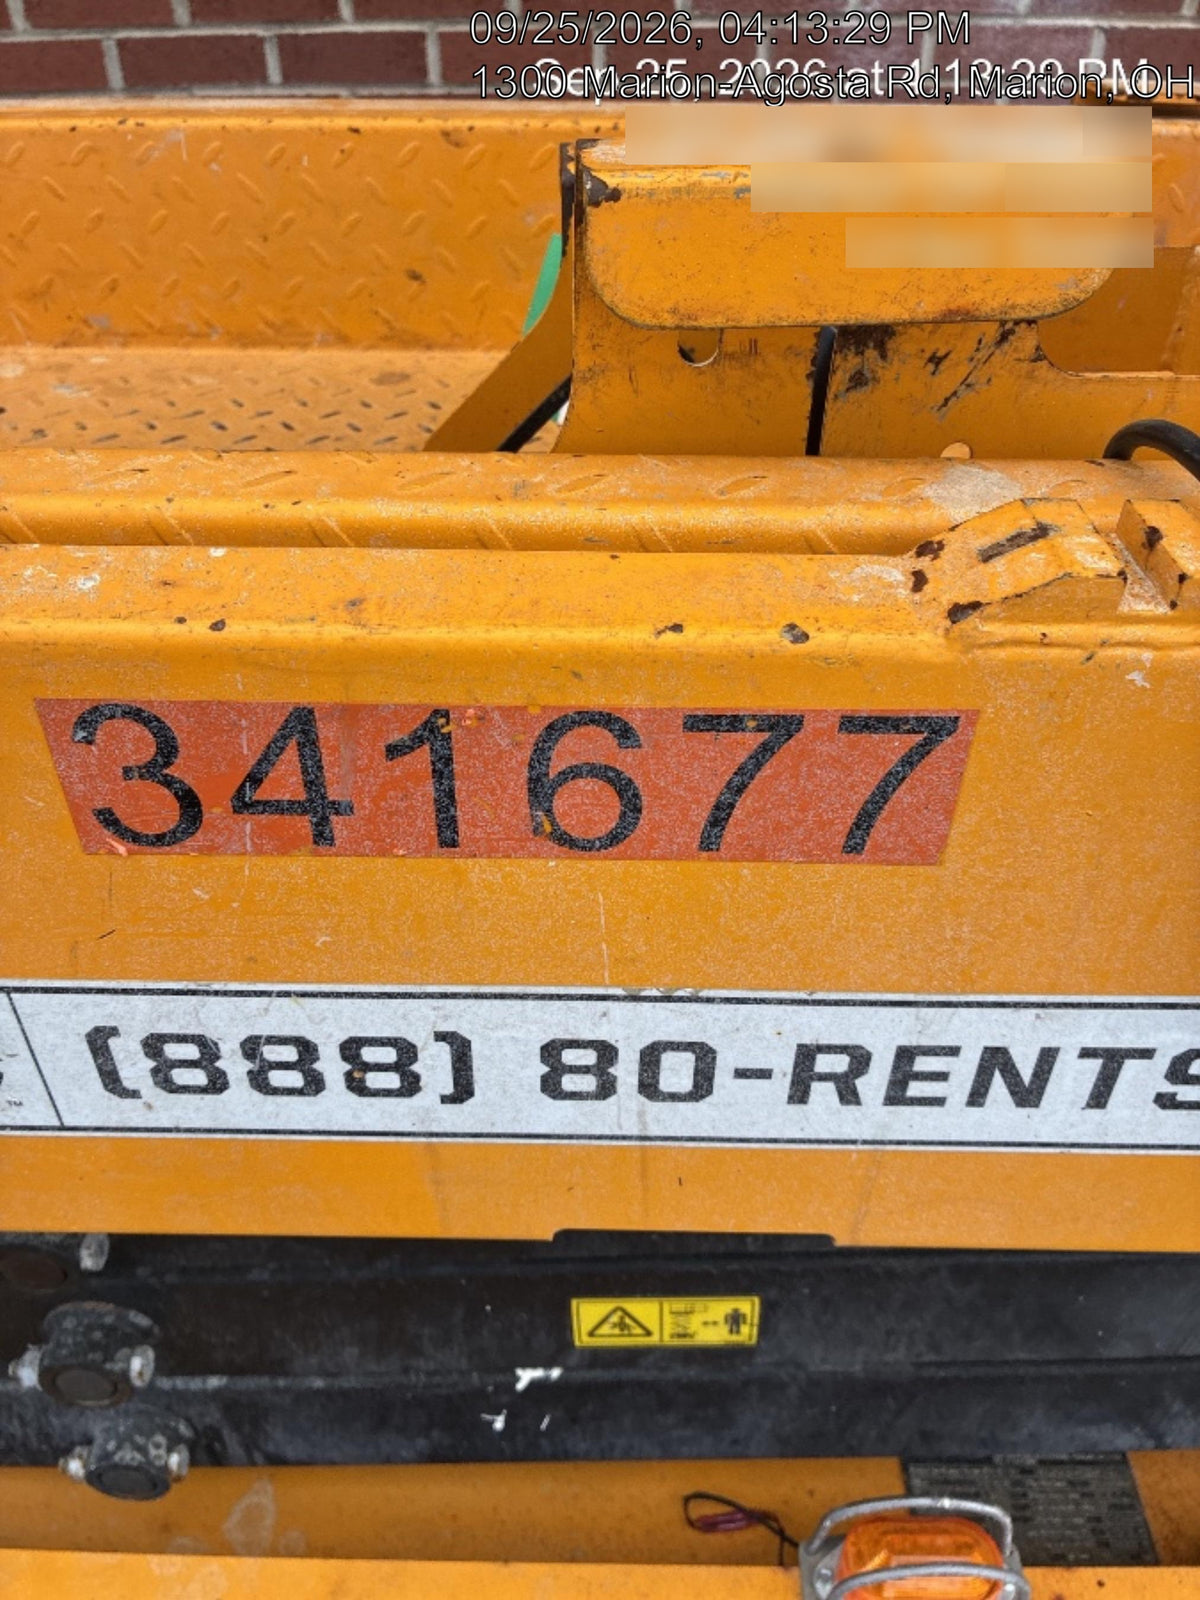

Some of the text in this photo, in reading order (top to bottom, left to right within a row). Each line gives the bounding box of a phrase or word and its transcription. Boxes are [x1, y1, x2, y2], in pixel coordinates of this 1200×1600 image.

[71, 702, 960, 855] 341677
[84, 1025, 476, 1105] (888)
[539, 1038, 1200, 1111] 80-RENTS
